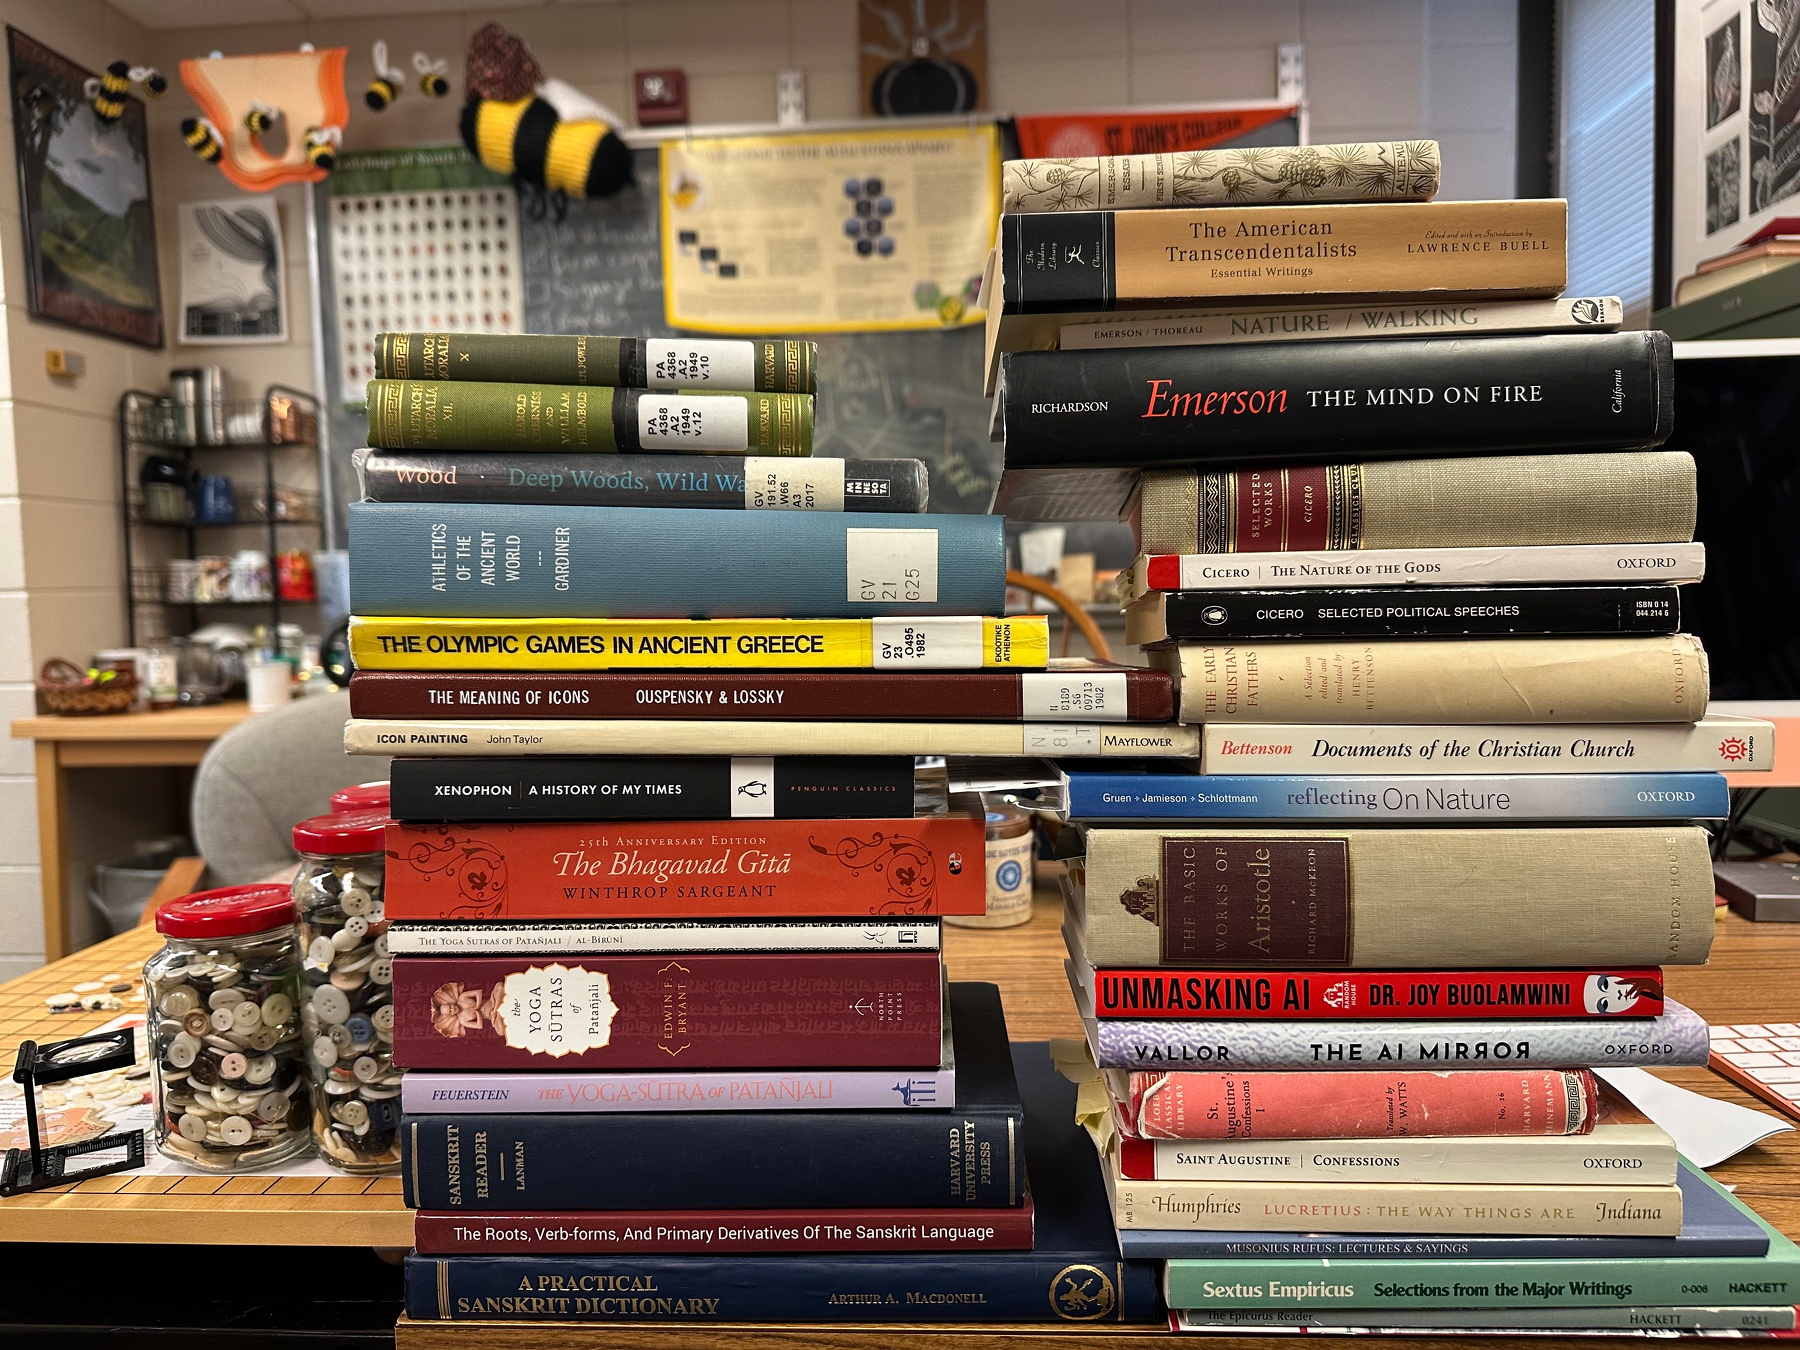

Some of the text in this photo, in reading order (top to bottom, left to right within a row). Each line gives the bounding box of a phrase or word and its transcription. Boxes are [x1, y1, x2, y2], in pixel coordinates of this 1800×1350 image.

[1122, 158, 1131, 192] ESSAYS
[1189, 220, 1333, 239] The American
[1166, 242, 1357, 263] Transcendentalists
[1407, 240, 1550, 254] LAWRENCE BUELL
[1211, 266, 1314, 279] Essential Writings
[1231, 313, 1329, 337] NATURE
[1361, 307, 1479, 329] WALKING
[1141, 378, 1289, 419] Emerson
[1307, 385, 1543, 407] THE MIND ON FIRE
[1611, 369, 1622, 413] California
[1031, 401, 1109, 414] RICHARDSON
[648, 418, 657, 435] PA
[659, 407, 668, 436] 4368
[671, 416, 679, 436] .A2
[682, 408, 690, 436] 1949
[761, 398, 770, 446] HARVARD
[397, 466, 457, 485] Wood
[1252, 473, 1261, 538] SELECTED
[1264, 481, 1273, 528] WORKS
[1304, 485, 1314, 523] CICERO
[432, 523, 447, 592] ATHLETICS
[456, 535, 471, 581] OF THE
[481, 530, 496, 586] ANCIENT
[506, 534, 520, 582] WORLD
[555, 526, 570, 591] GARDINER
[1616, 557, 1676, 570] OXFORD
[1256, 605, 1520, 620] CICERO SELECTED POLITICAL SPEECHES
[377, 634, 824, 654] THE OLYMPIC GAMES IN ANCIENT GREECE
[1203, 646, 1217, 716] THE EARLY
[1224, 646, 1238, 715] CHRISTIAN
[1246, 651, 1259, 708] FATHERS
[429, 689, 590, 705] THE MEANING OF ICONS
[635, 689, 784, 704] OUSPENSKY & LOSSKY
[377, 734, 468, 744] ICON PAINTING
[486, 734, 543, 745] John Taylor
[1221, 737, 1636, 760] Bettenson Documents of the Christian Church
[434, 785, 512, 796] XENOPHON
[528, 784, 682, 796] A HISTORY OF MY TIMES
[1102, 792, 1258, 804] Gruen Jamieson Schlottmann
[1286, 787, 1511, 811] reflecting On Nature
[1637, 790, 1696, 802] OXFORD
[553, 849, 792, 883] The Bhagavad Gītā
[563, 885, 777, 899] WINTHROP SARGEANT
[1246, 847, 1271, 954] Aristotle
[1102, 976, 1311, 1012] UNMASKING AI
[1369, 983, 1571, 1006] DR. JOY BUOLAMWINI
[529, 986, 542, 1034] YOGA
[547, 977, 563, 1042] SŪTRAS
[588, 983, 602, 1035] Patañjali
[677, 983, 687, 1034] BRYANT
[1134, 1044, 1231, 1061] VALLOR
[1310, 1043, 1363, 1061] THE
[1377, 1042, 1403, 1060] AI
[1604, 1044, 1673, 1055] OXFORD
[432, 1089, 510, 1101] FEUERSTEIN
[538, 1088, 563, 1100] THE
[708, 1088, 725, 1099] OF
[729, 1076, 833, 1102] PATAÑJALI
[1176, 1083, 1185, 1131] LIBRARY
[447, 1125, 462, 1205] SANSKRIT
[475, 1131, 489, 1199] READER
[981, 1141, 990, 1184] PRESS
[1177, 1152, 1291, 1166] SAINT AUGUSTINE
[1313, 1154, 1400, 1167] CONFESSIONS
[1583, 1157, 1643, 1169] OXFORD
[1151, 1193, 1241, 1223] Humphries
[1596, 1198, 1662, 1222] Indiana
[453, 1224, 995, 1243] The Roots, Verb-forms, And Primary Derivatives Of The Sanskrit Language
[1226, 1242, 1469, 1254] MUSONIUS RUFUS: LECTURES & SAYINGS
[518, 1275, 658, 1291] A PRACTICAL
[1203, 1281, 1354, 1301] Sextus Empiricus
[1373, 1281, 1633, 1300] Selections from the Major Writings
[457, 1297, 720, 1315] SANSKRIT DICTIONARY
[1206, 1310, 1314, 1323] The Epicurus Reader
